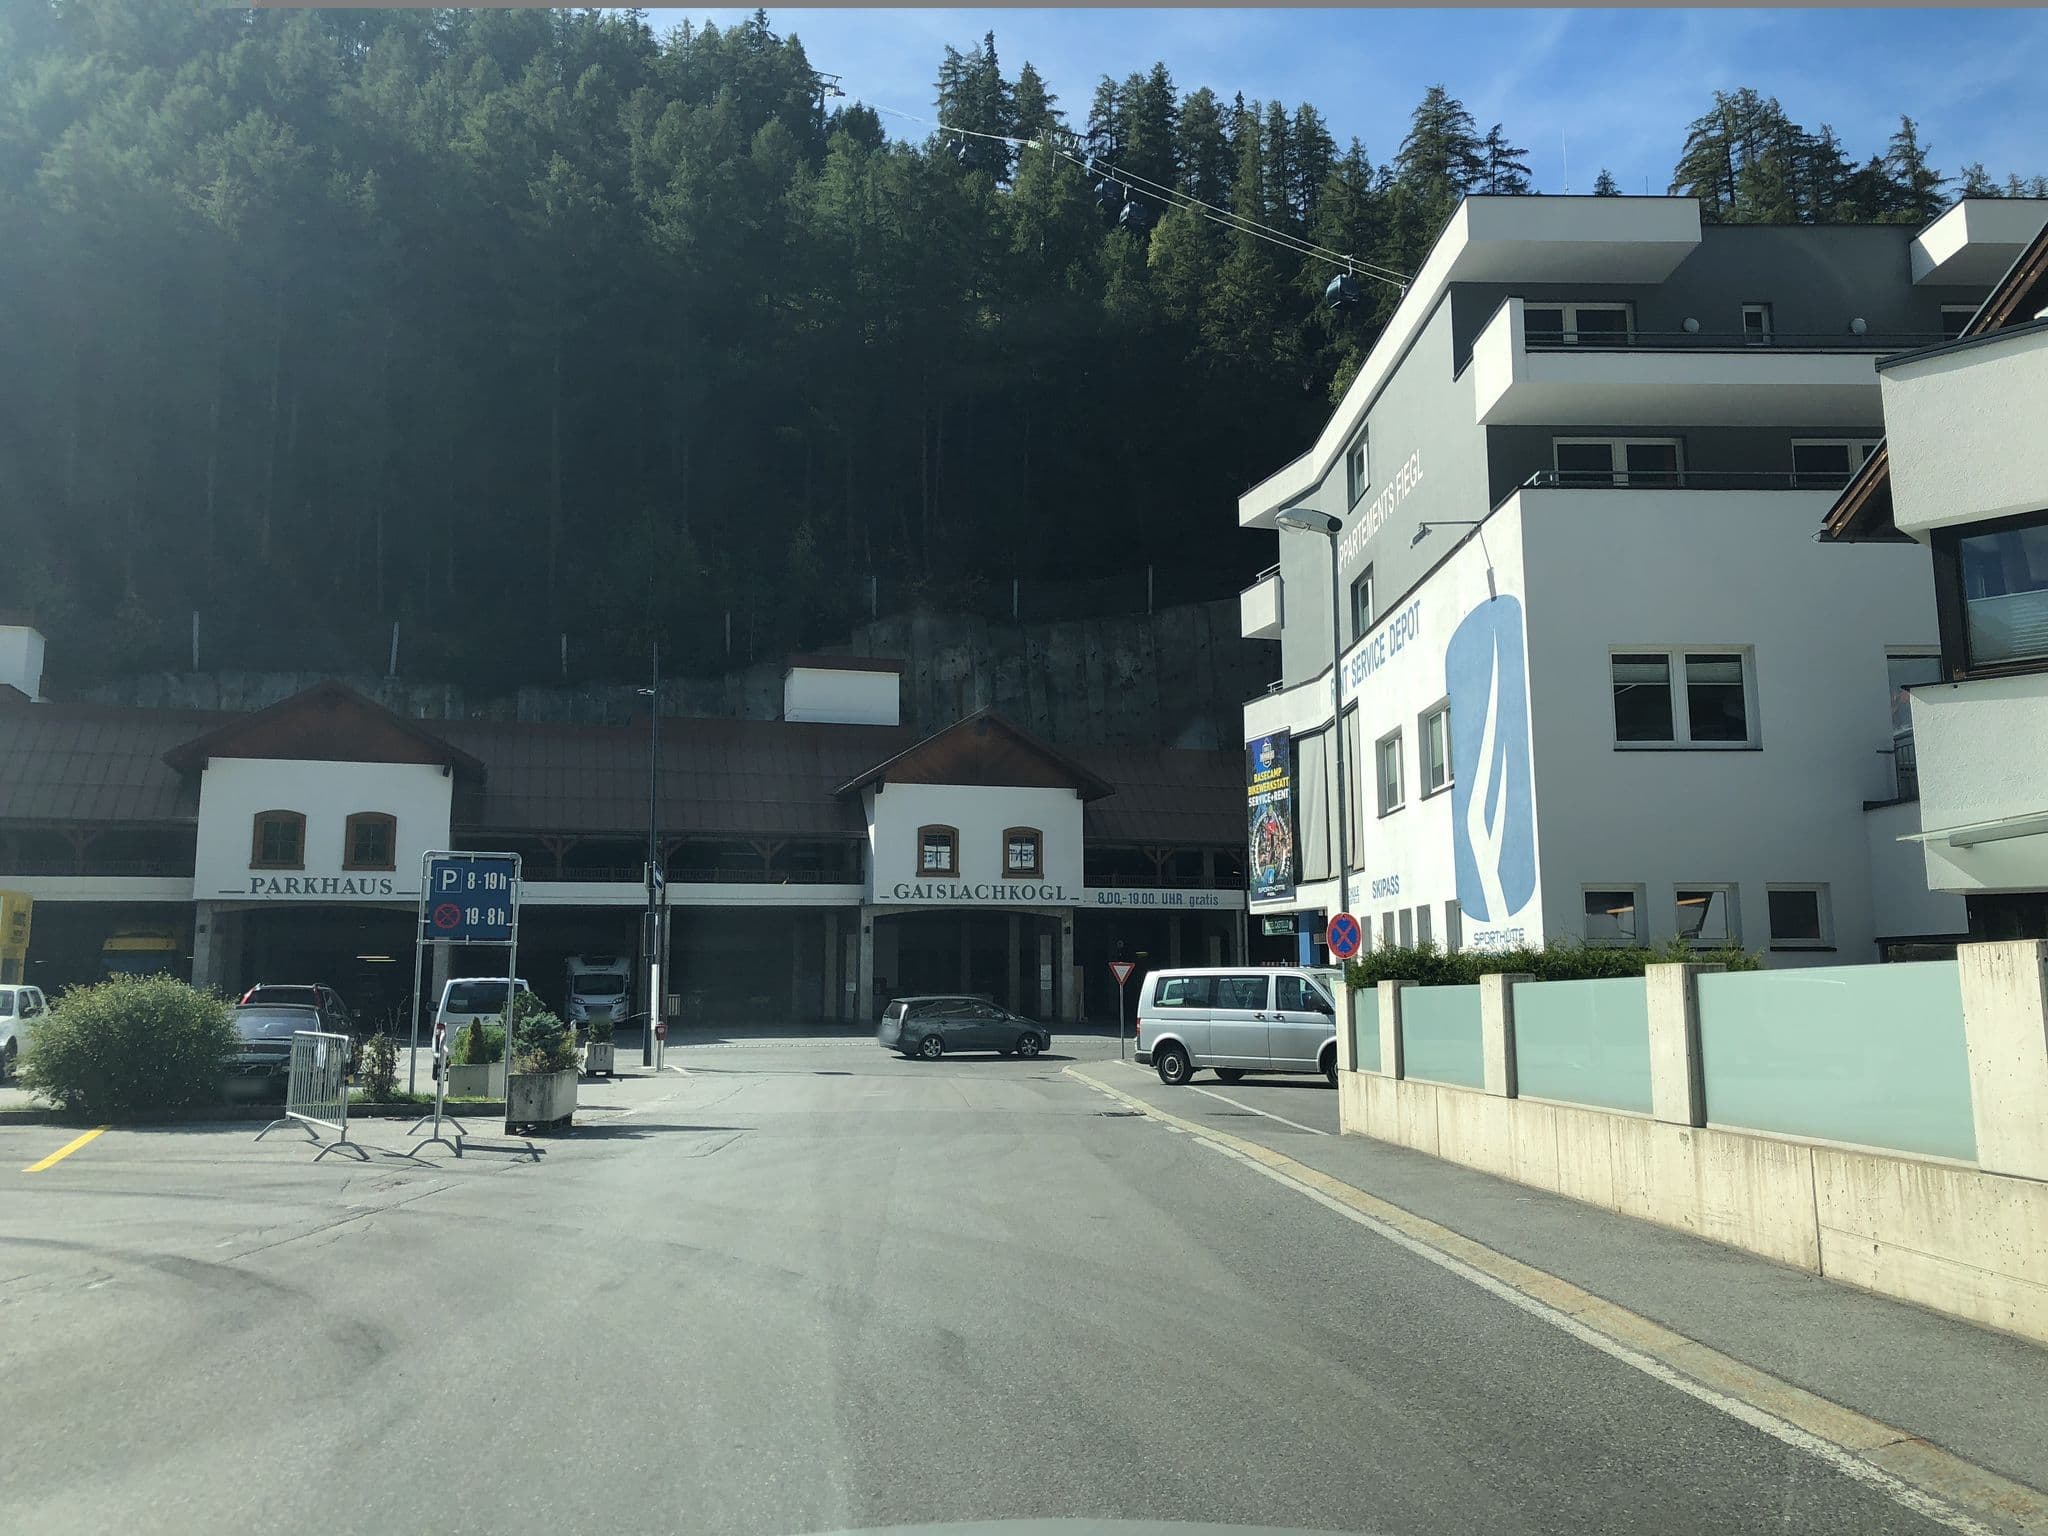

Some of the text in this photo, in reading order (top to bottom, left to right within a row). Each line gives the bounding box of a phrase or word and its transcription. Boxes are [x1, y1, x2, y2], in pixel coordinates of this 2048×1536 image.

[1396, 449, 1423, 505] FIEGL
[1352, 632, 1385, 688] SERVICE
[1390, 600, 1420, 657] DEPOT
[1253, 767, 1282, 783] BASECAMP
[250, 877, 393, 896] PARKHAUS
[442, 870, 458, 891] P
[1372, 874, 1400, 900] SKIPASS
[893, 882, 1067, 901] GAISLACHKOGL
[1161, 893, 1183, 906] UHR
[1189, 894, 1220, 908] gratis
